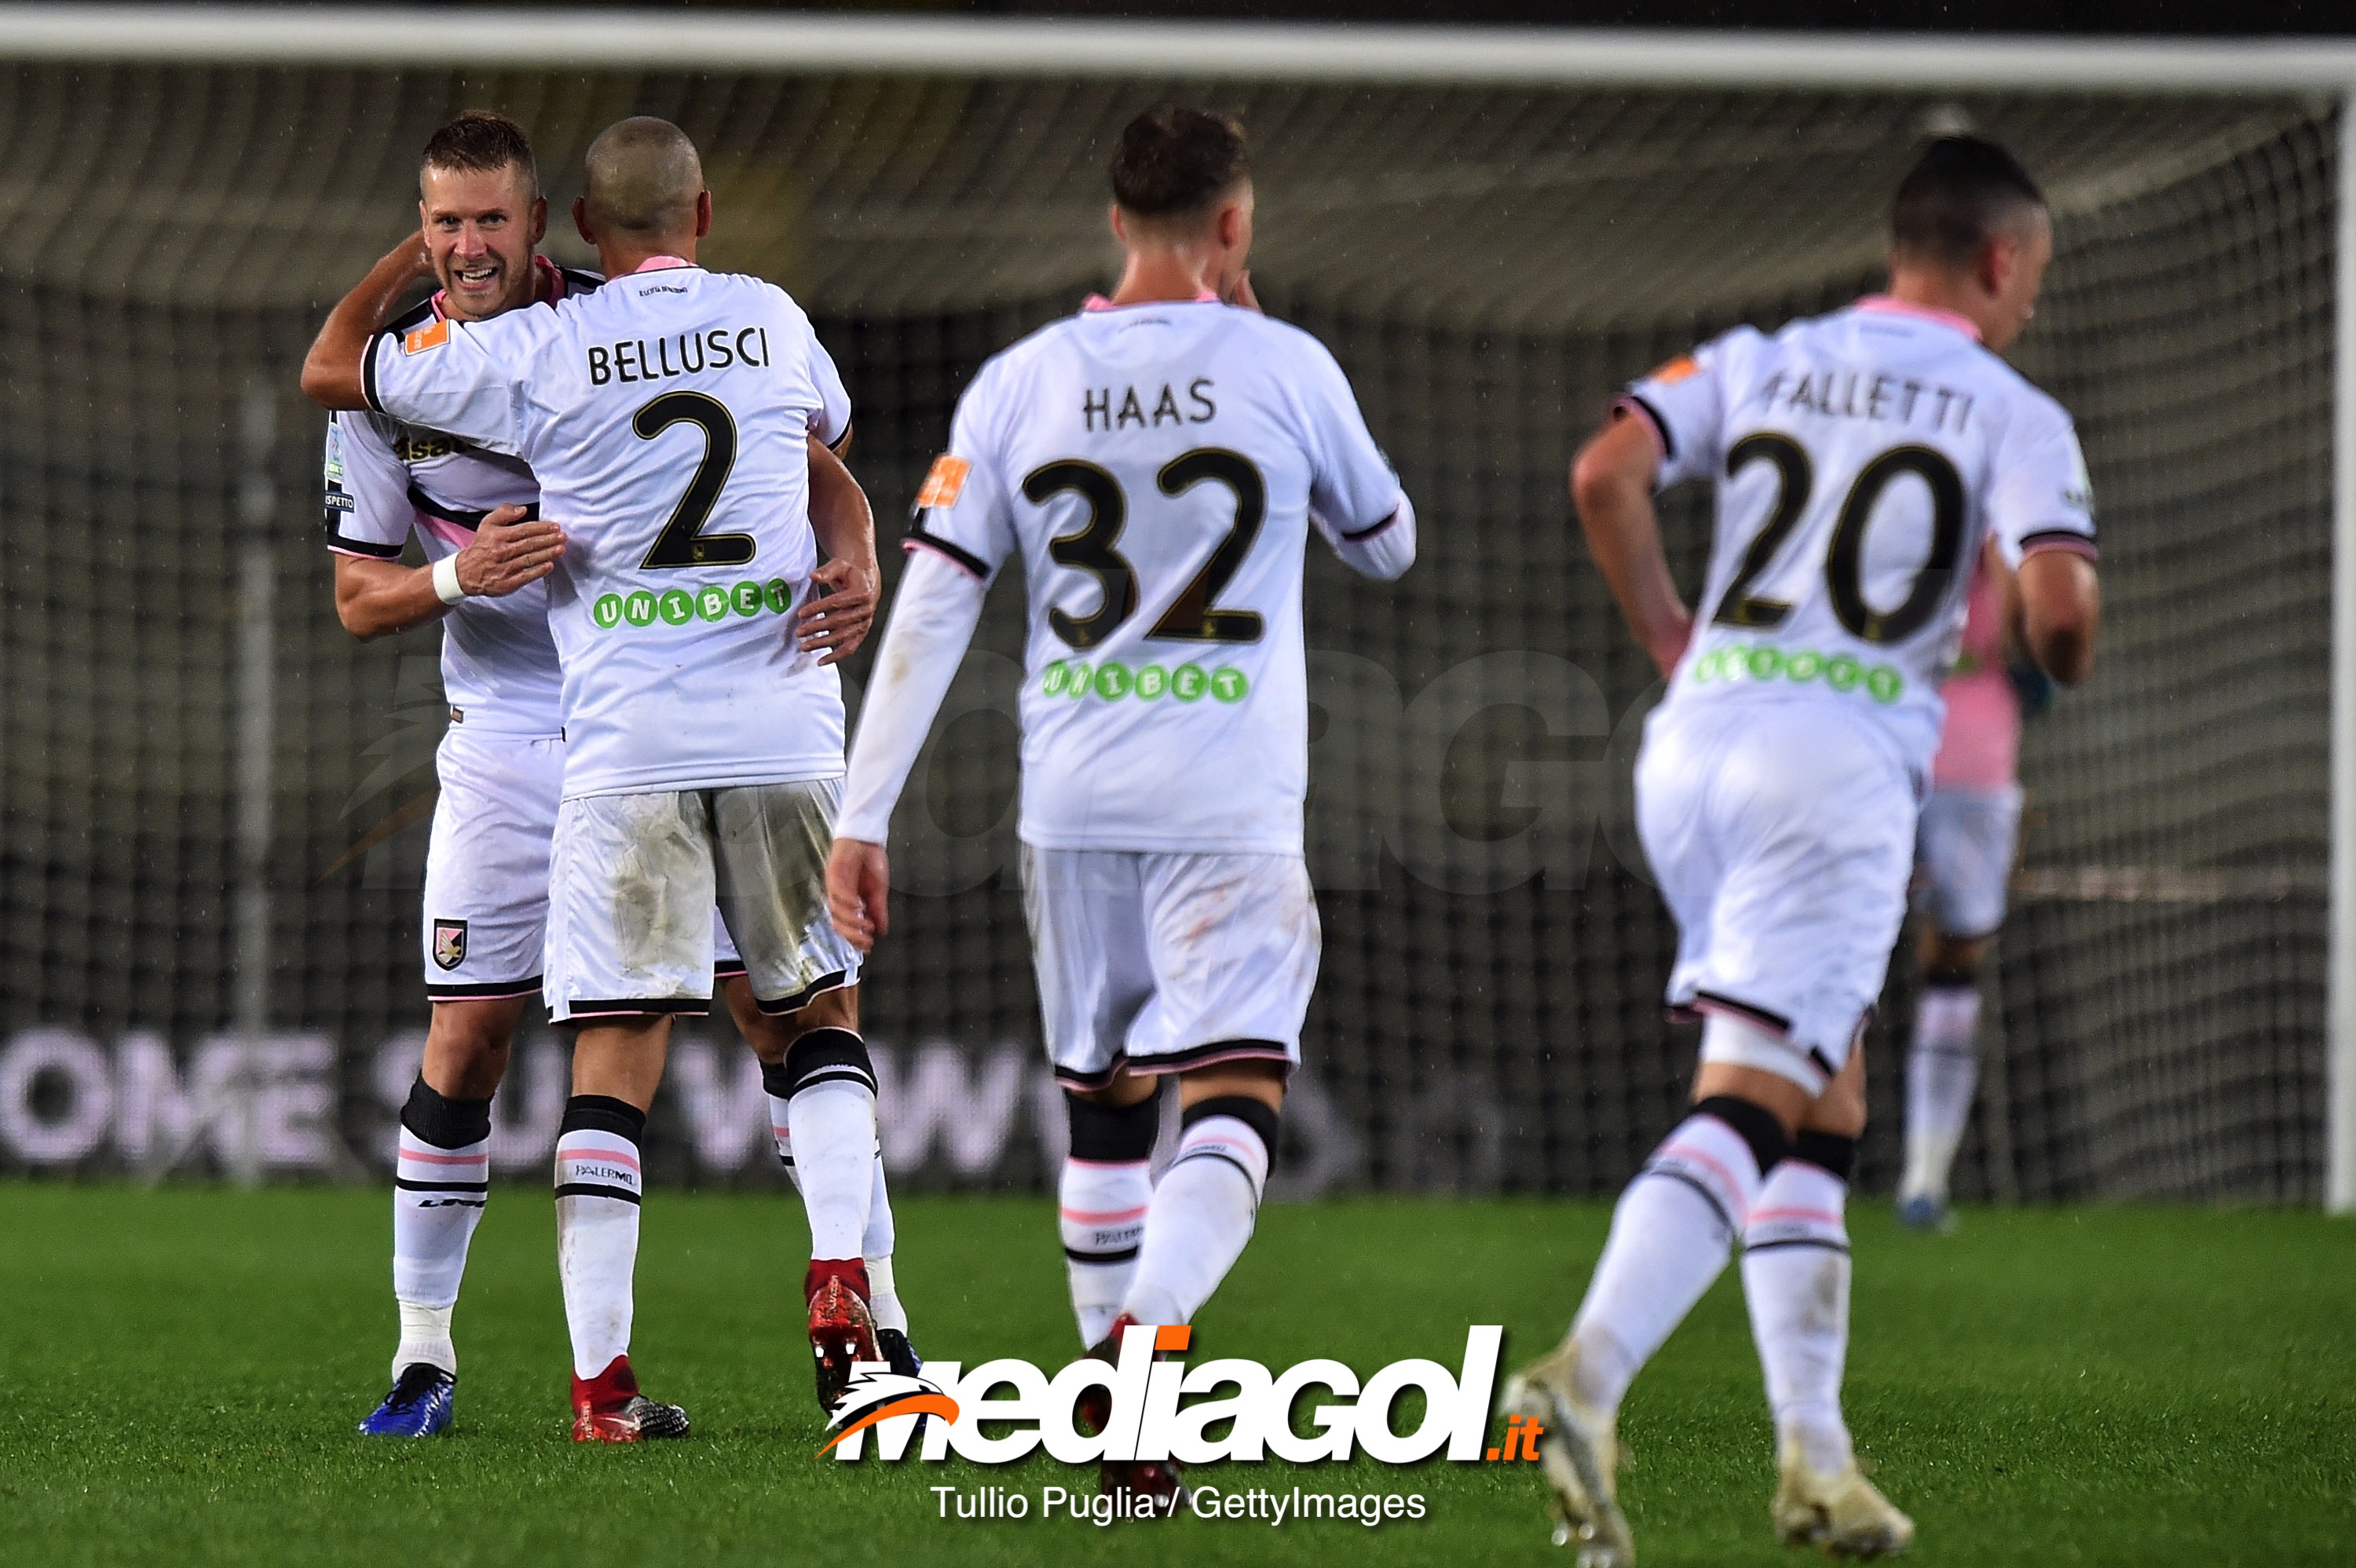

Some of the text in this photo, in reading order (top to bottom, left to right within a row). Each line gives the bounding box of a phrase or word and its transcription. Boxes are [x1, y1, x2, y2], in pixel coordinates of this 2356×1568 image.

[587, 327, 770, 386] BELLUSCI
[1083, 378, 1216, 433] HAAS
[631, 389, 756, 570] 2
[1021, 445, 1268, 651] 32
[1712, 431, 1967, 648] 20
[595, 577, 791, 627] UNIBET
[1043, 661, 1247, 702] UNIBET
